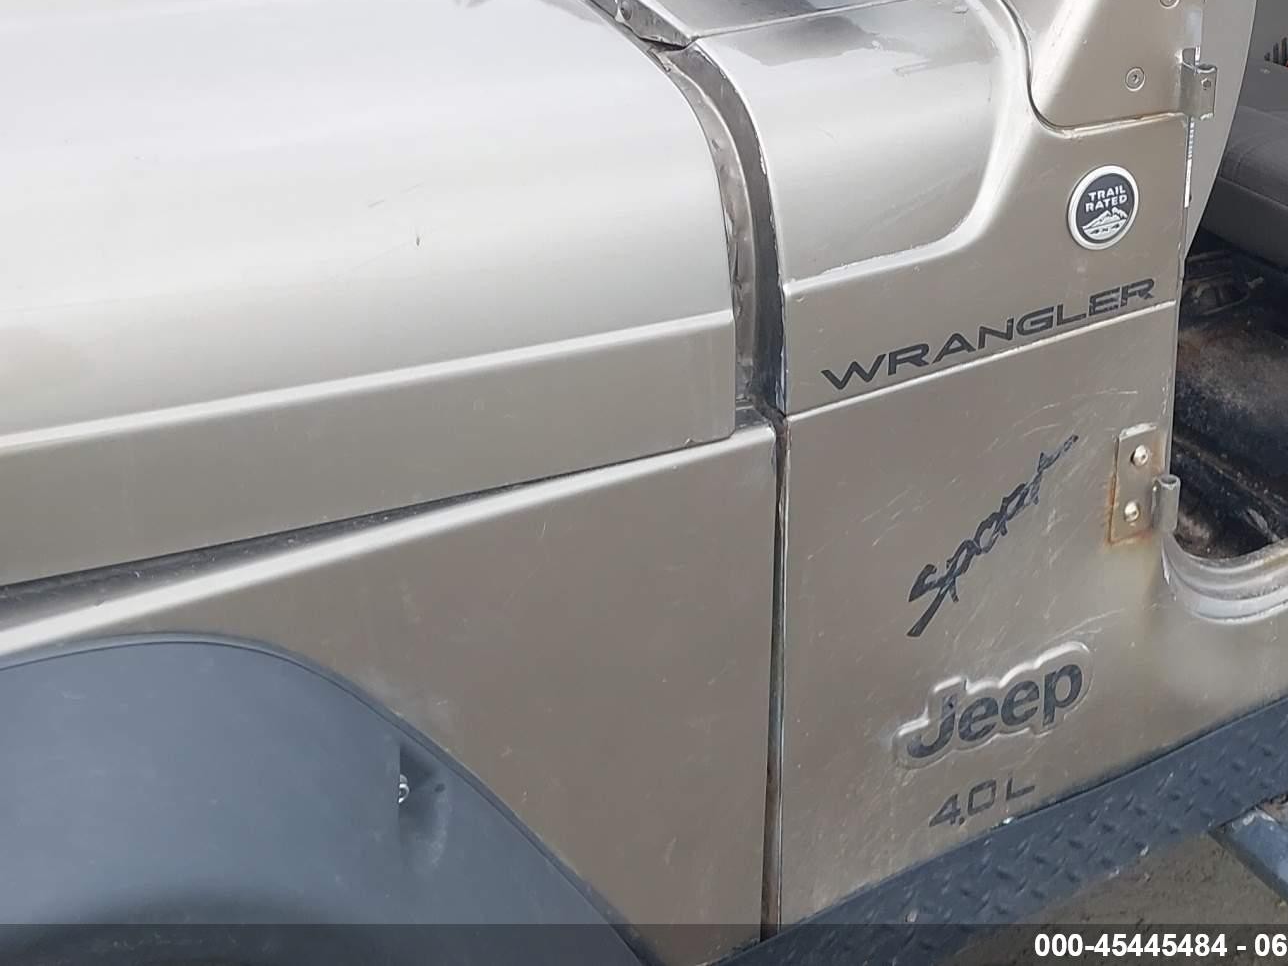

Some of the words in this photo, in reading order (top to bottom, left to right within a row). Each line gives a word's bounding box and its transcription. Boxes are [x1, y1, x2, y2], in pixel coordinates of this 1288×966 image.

[1085, 194, 1128, 213] RATED
[1088, 185, 1126, 202] TRAIL
[821, 278, 1155, 390] WRANGLER
[905, 663, 1083, 759] Jeep
